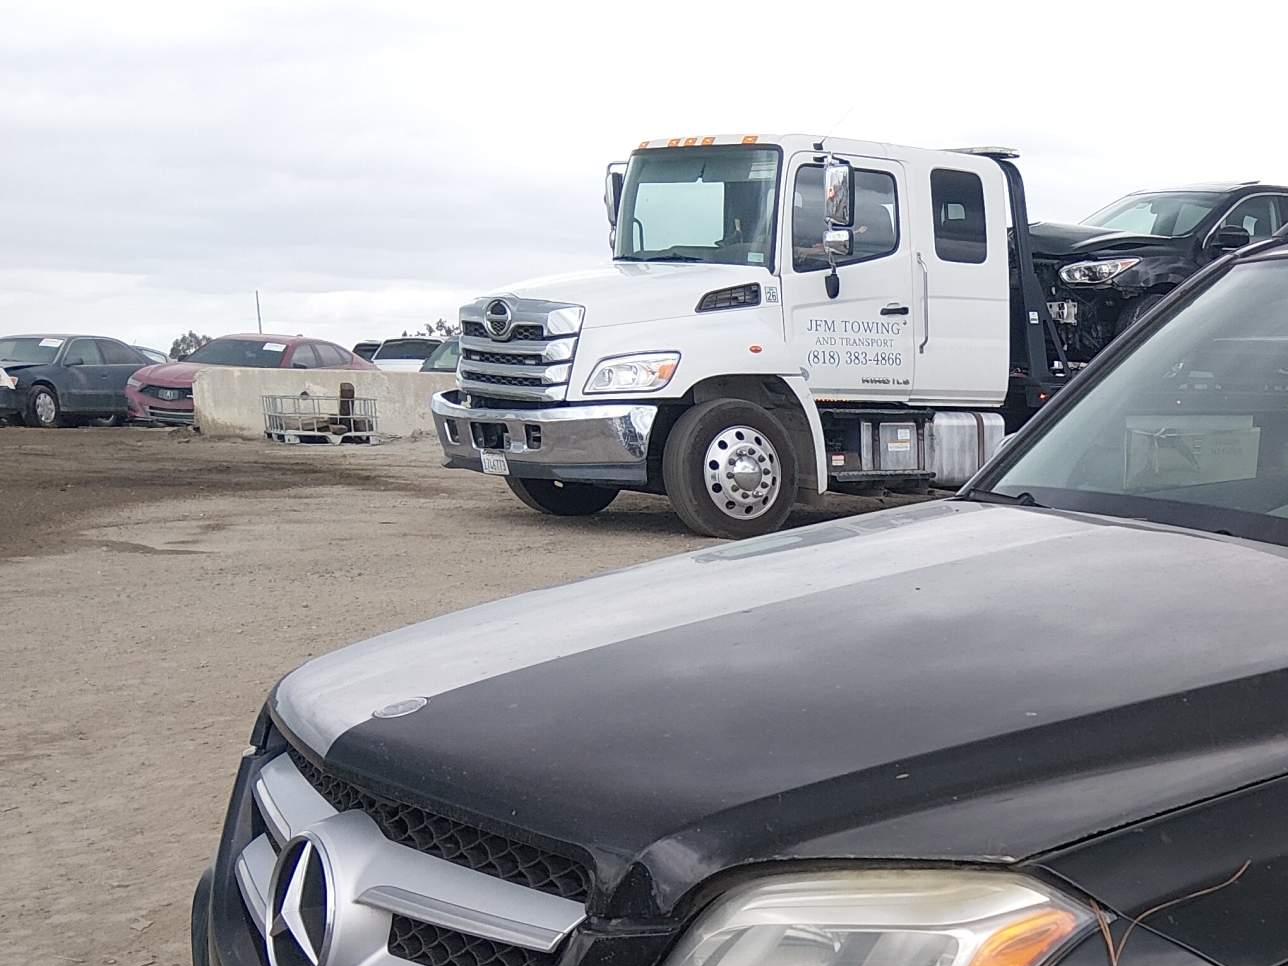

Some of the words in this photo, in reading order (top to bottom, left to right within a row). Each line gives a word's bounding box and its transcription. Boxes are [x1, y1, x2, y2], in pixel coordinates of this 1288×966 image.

[766, 290, 777, 301] 26
[807, 319, 836, 333] JFM
[841, 320, 901, 335] TOWING
[815, 336, 837, 346] AND
[839, 337, 895, 348] TRANSPORT
[807, 349, 841, 367] (818)
[845, 351, 902, 367] 383-4866
